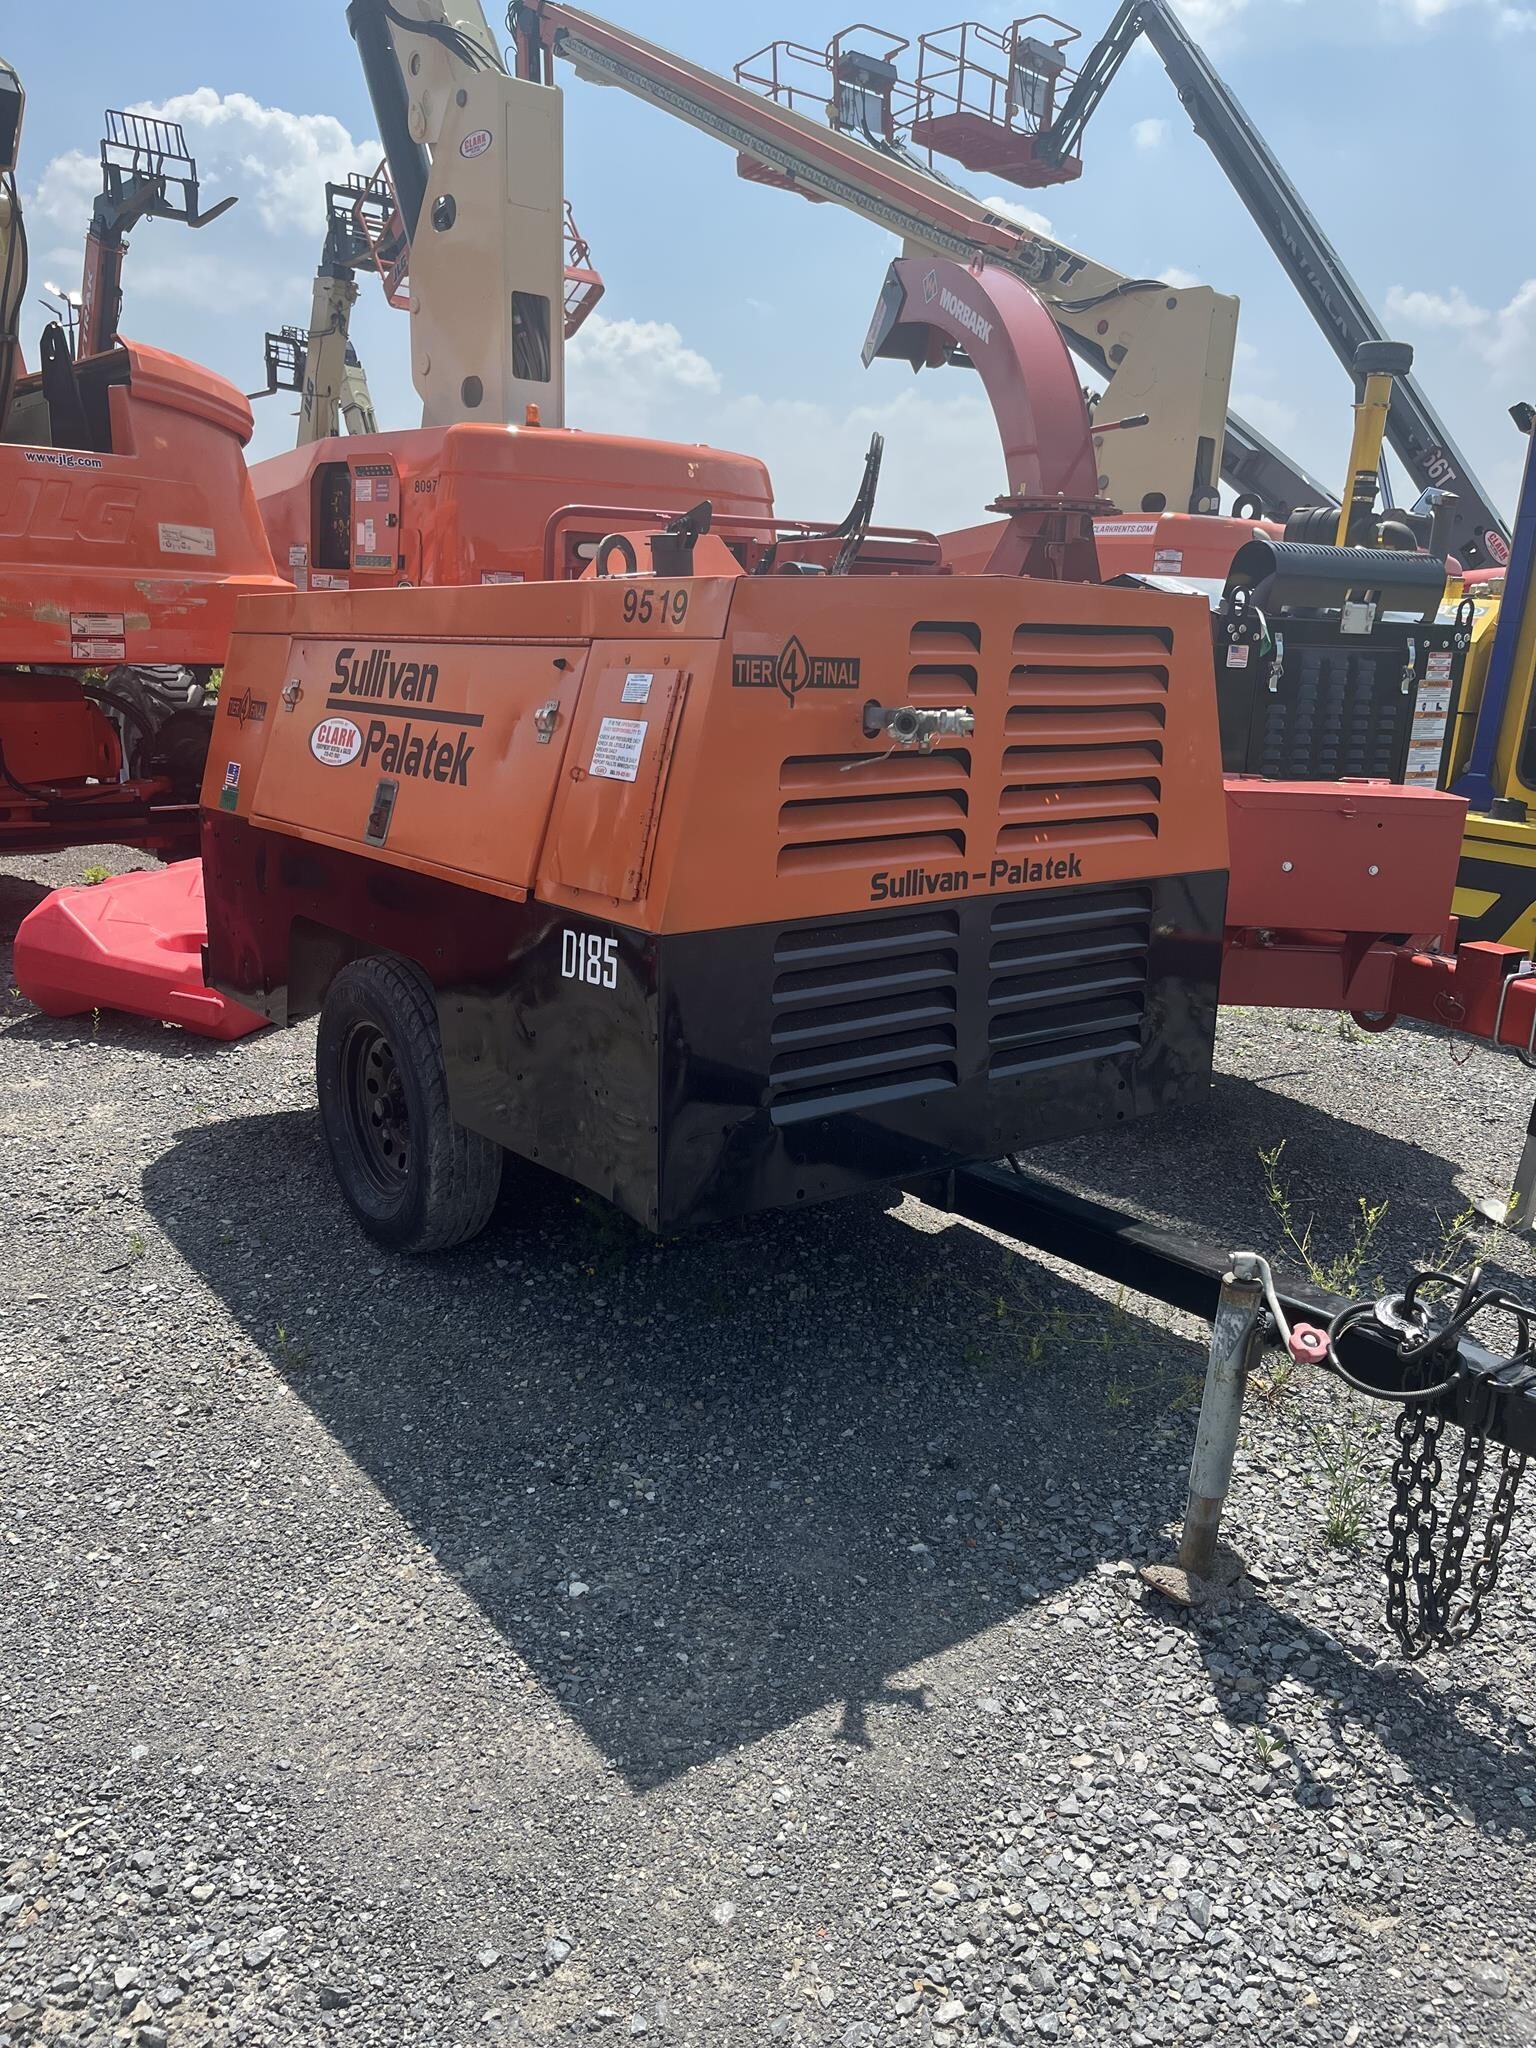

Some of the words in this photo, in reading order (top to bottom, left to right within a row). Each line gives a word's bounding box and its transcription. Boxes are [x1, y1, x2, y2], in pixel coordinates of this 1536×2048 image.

[940, 287, 993, 345] MORBARK
[25, 451, 102, 469] www.jlg.com
[414, 480, 438, 493] 8097
[1488, 533, 1509, 561] CLARK
[623, 588, 688, 625] 9519
[329, 647, 439, 703] Sullivan
[735, 659, 772, 684] TIER
[783, 649, 798, 692] 4
[814, 661, 857, 685] FINAL
[317, 724, 357, 748] CLARK
[360, 719, 475, 787] Palatek
[561, 929, 618, 990] D185
